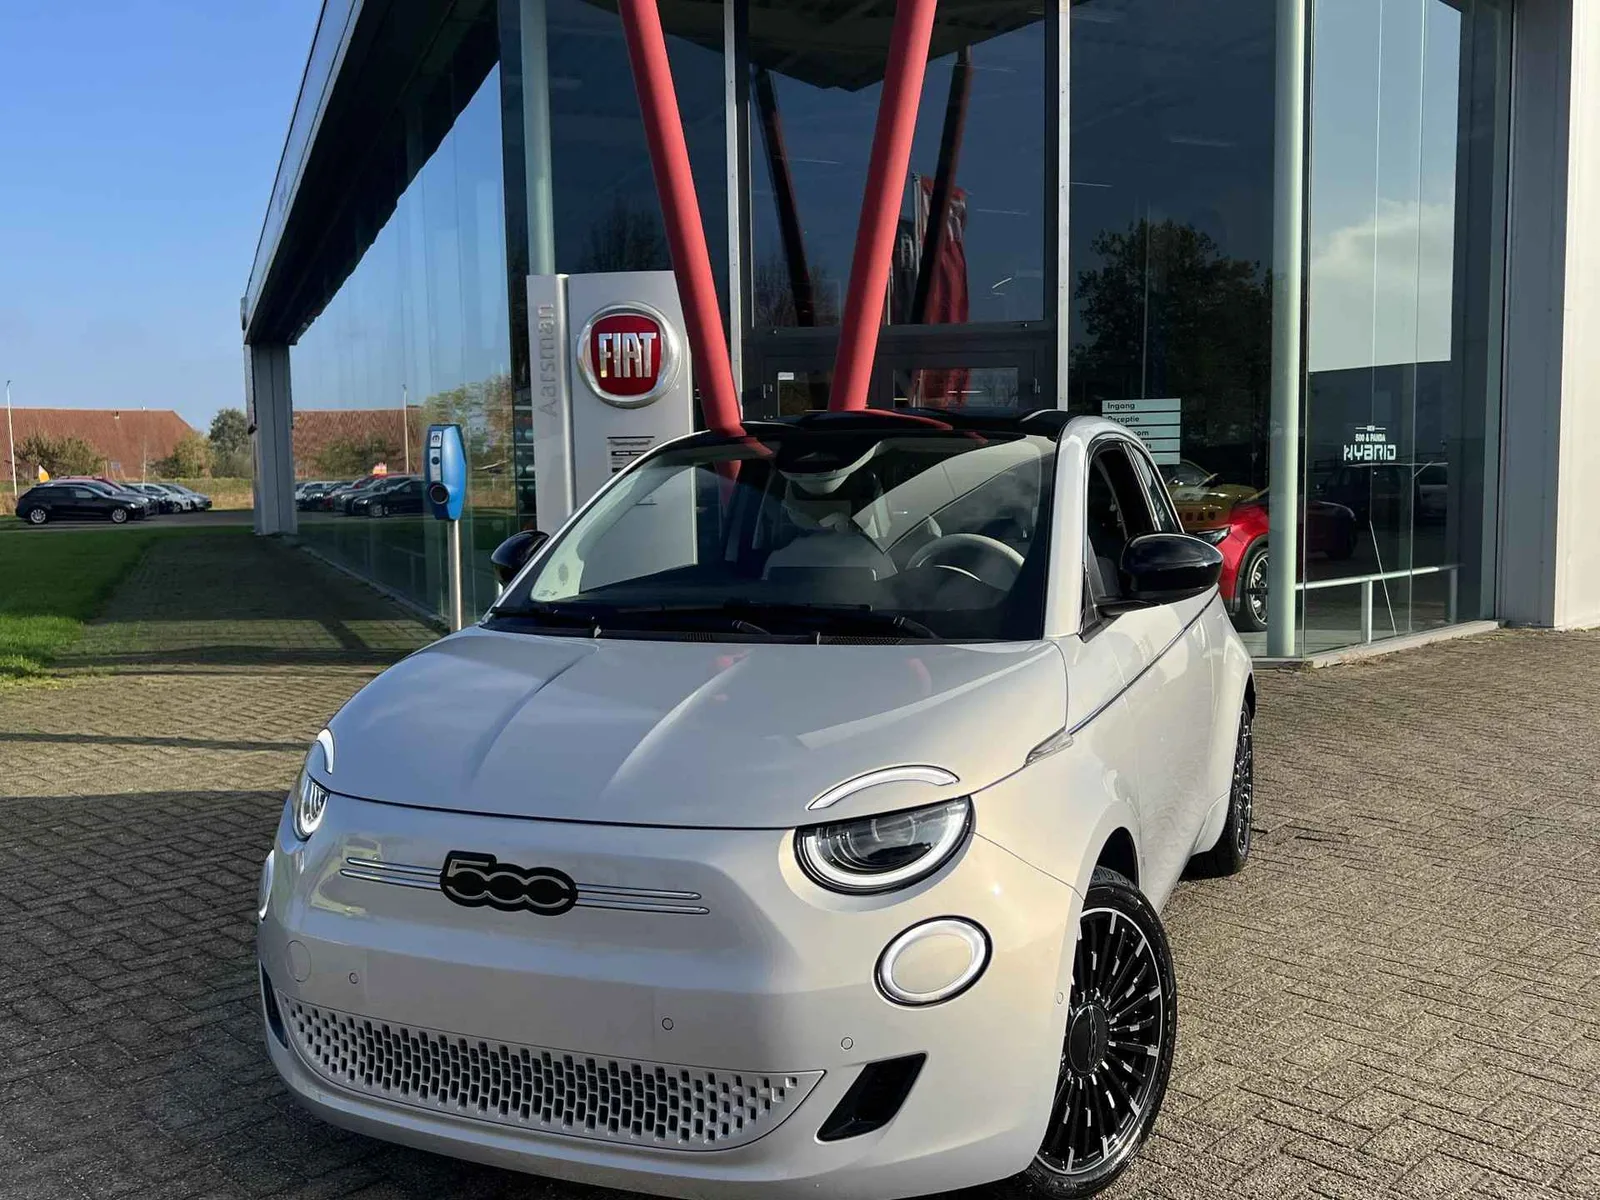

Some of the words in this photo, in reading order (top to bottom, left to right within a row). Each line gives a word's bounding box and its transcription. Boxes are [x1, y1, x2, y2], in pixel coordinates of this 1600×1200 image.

[538, 303, 557, 418] Aarsman
[598, 332, 657, 378] FIAT
[1107, 402, 1135, 410] Ingang
[1343, 444, 1396, 461] HYBRID
[445, 857, 571, 910] 500
